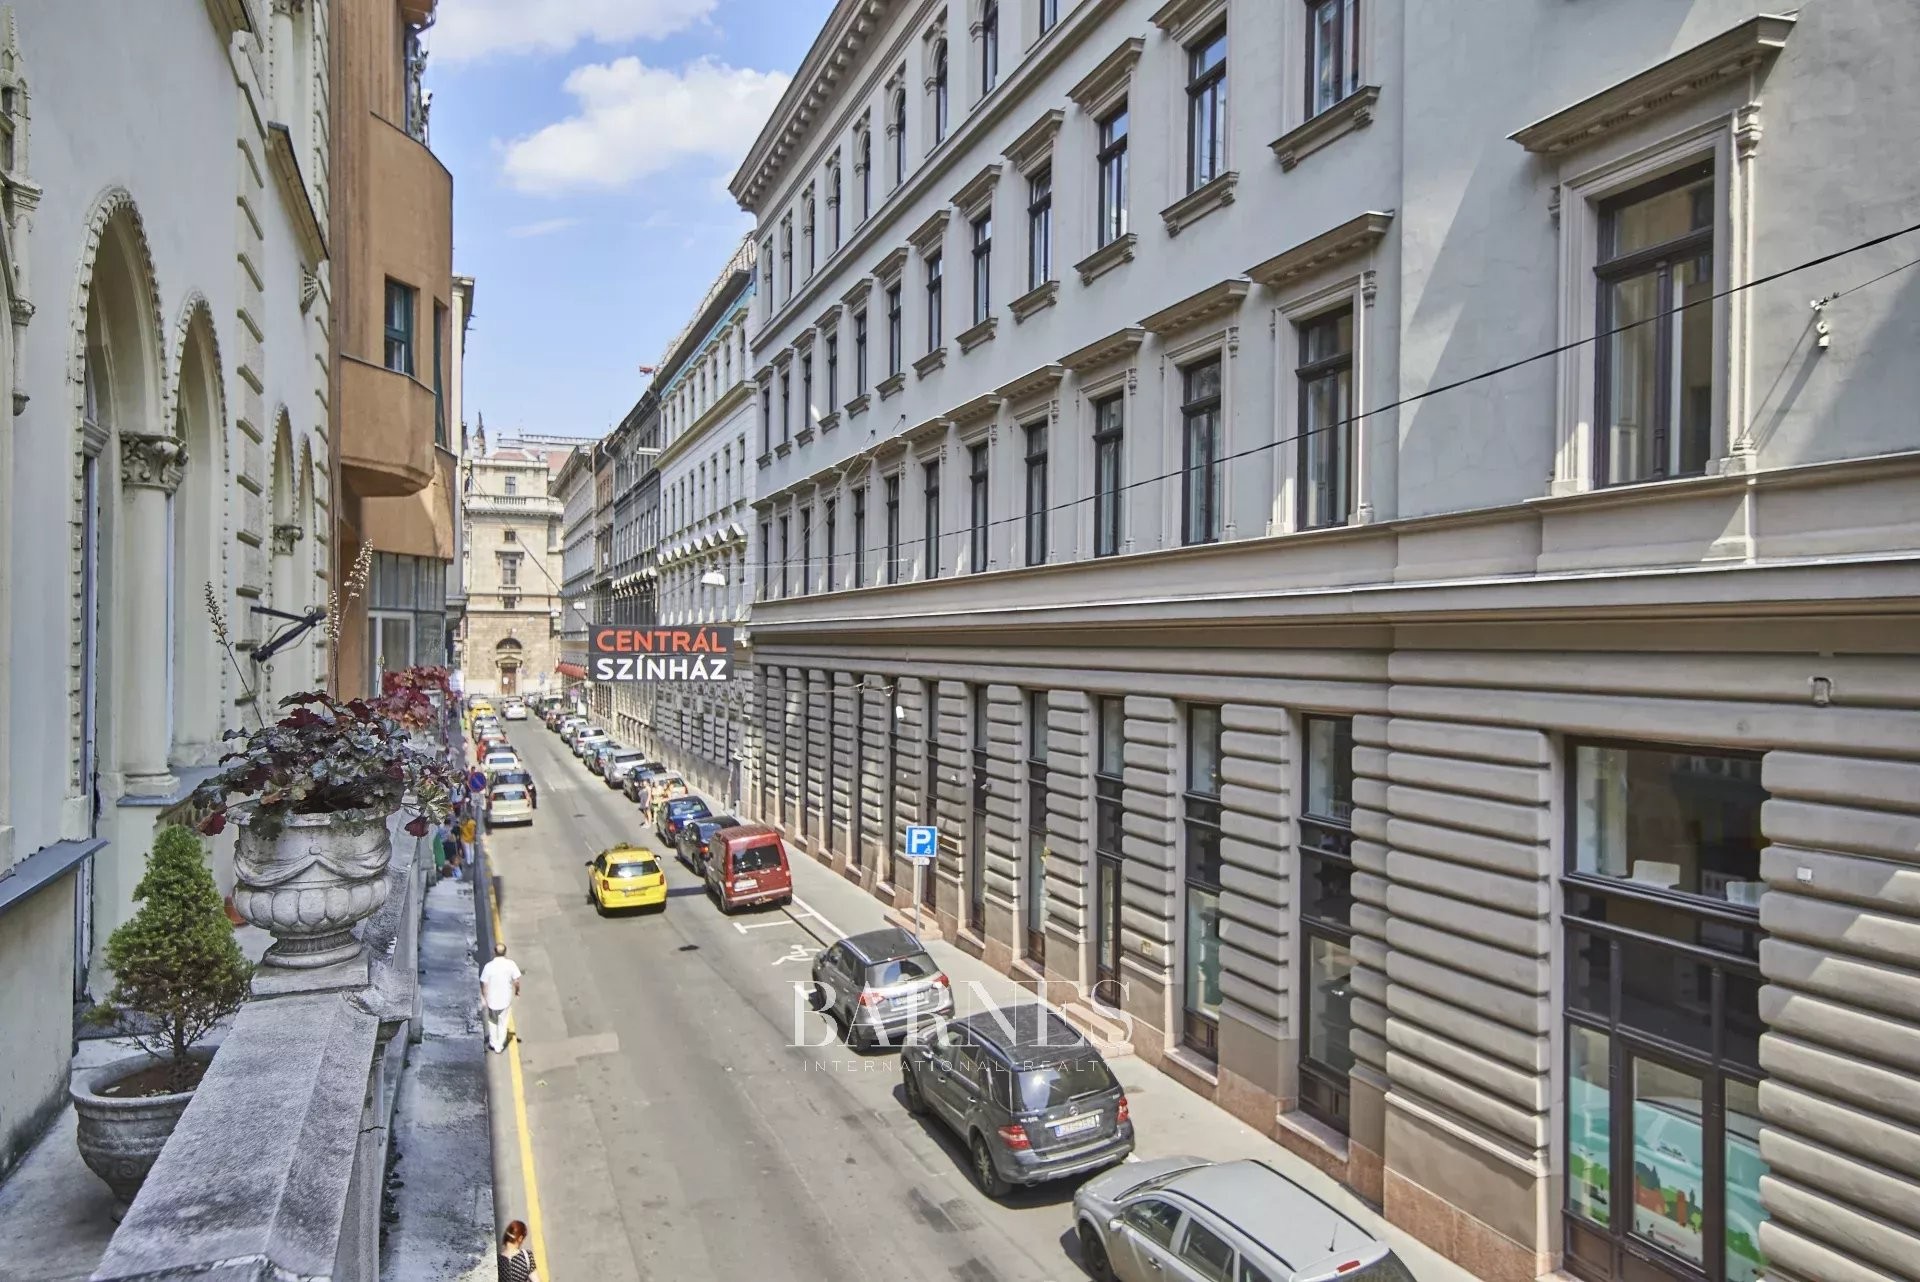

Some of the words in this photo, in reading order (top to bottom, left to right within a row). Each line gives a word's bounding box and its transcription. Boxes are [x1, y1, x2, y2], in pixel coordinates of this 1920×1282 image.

[596, 627, 727, 652] CENTRÁL
[596, 654, 727, 680] SZÍNHÁZ
[911, 828, 932, 853] P
